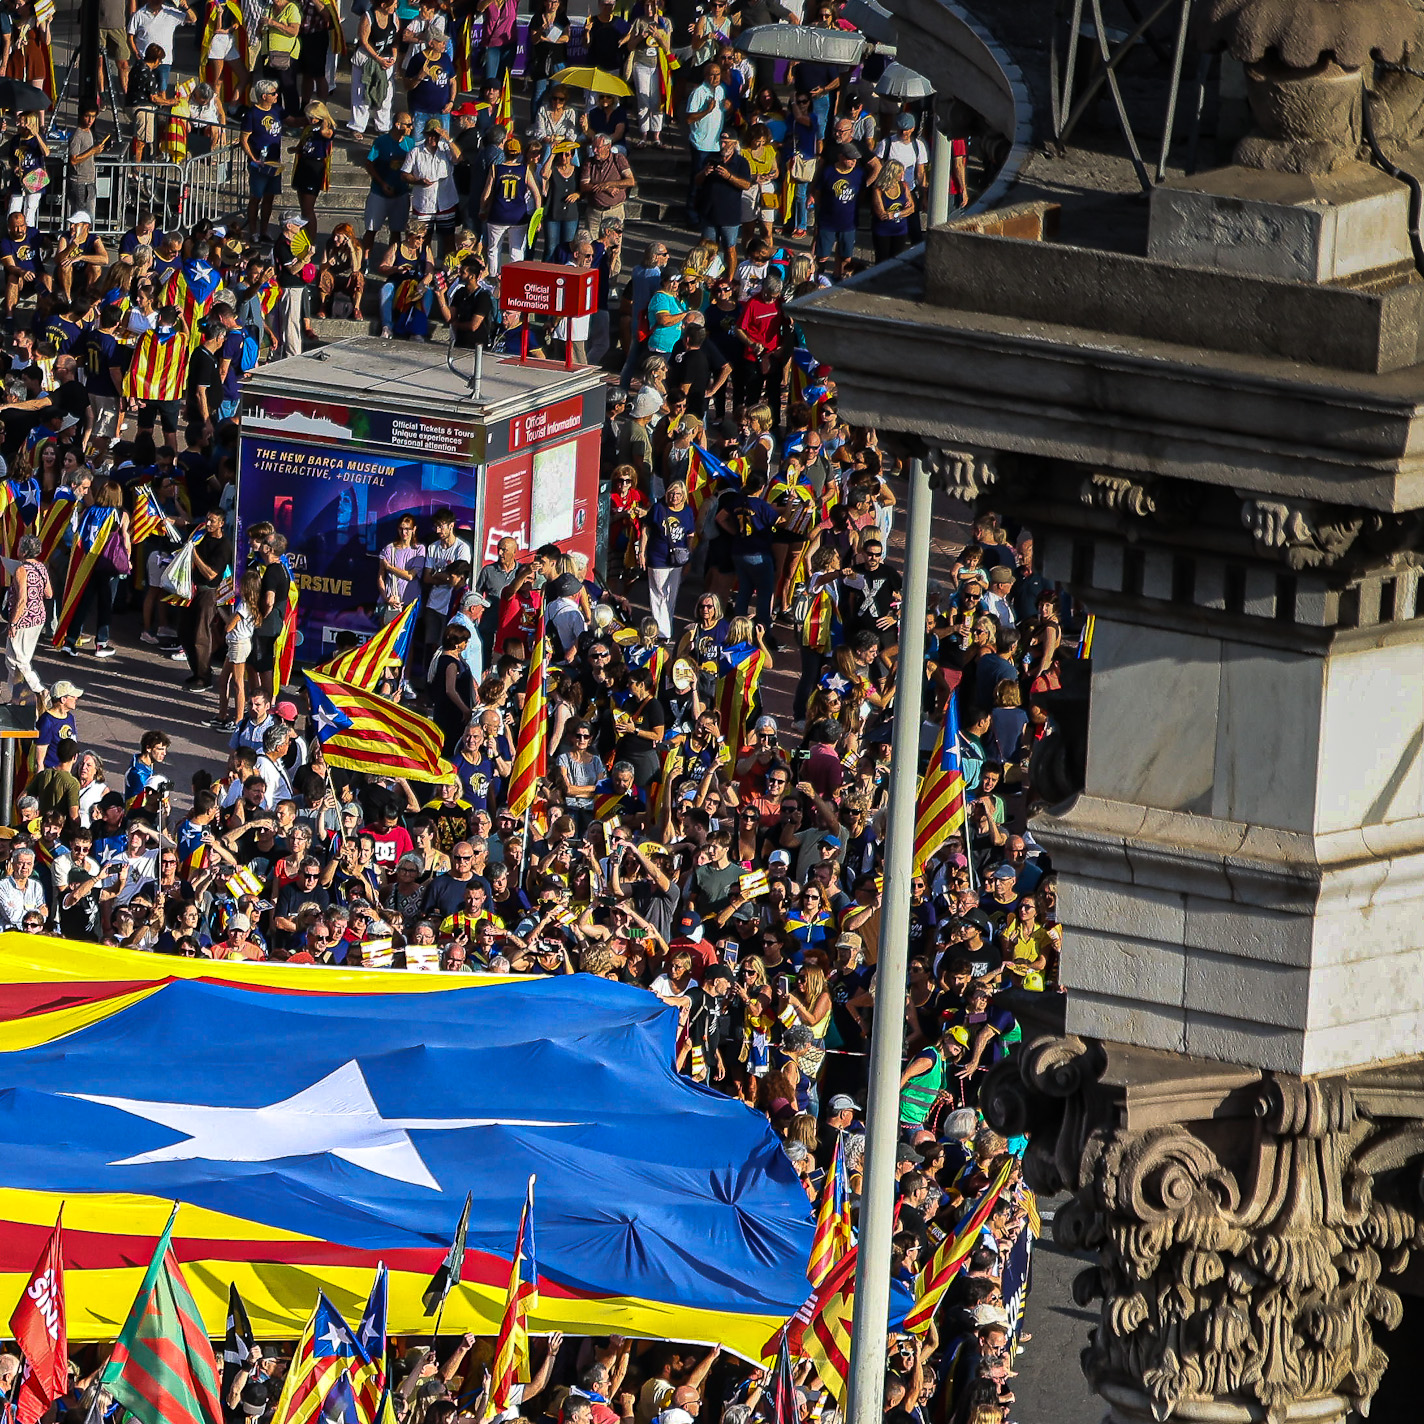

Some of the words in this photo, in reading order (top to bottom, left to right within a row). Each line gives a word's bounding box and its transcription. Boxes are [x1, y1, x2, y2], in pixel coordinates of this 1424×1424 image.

[501, 179, 517, 199] 11
[523, 283, 550, 294] Official
[524, 291, 550, 303] Tourist
[507, 296, 550, 310] Information
[392, 420, 418, 430] Official
[418, 423, 445, 434] Tickets
[446, 427, 453, 435] &
[453, 428, 475, 439] Tours
[525, 411, 547, 431] Official
[525, 425, 547, 443] Tourist
[546, 414, 581, 436] Information
[391, 427, 417, 439] Unique
[418, 431, 462, 445] experiences
[391, 435, 422, 446] Personal
[423, 440, 458, 452] attention
[256, 448, 278, 460] THE
[280, 451, 306, 463] NEW
[307, 454, 345, 471] BARÇA
[346, 461, 395, 477] MUSEUM
[253, 462, 332, 481] +INTERACTIVE,
[335, 472, 386, 487] +DIGITAL
[292, 573, 353, 597] ERSIVE
[375, 842, 396, 860] DC
